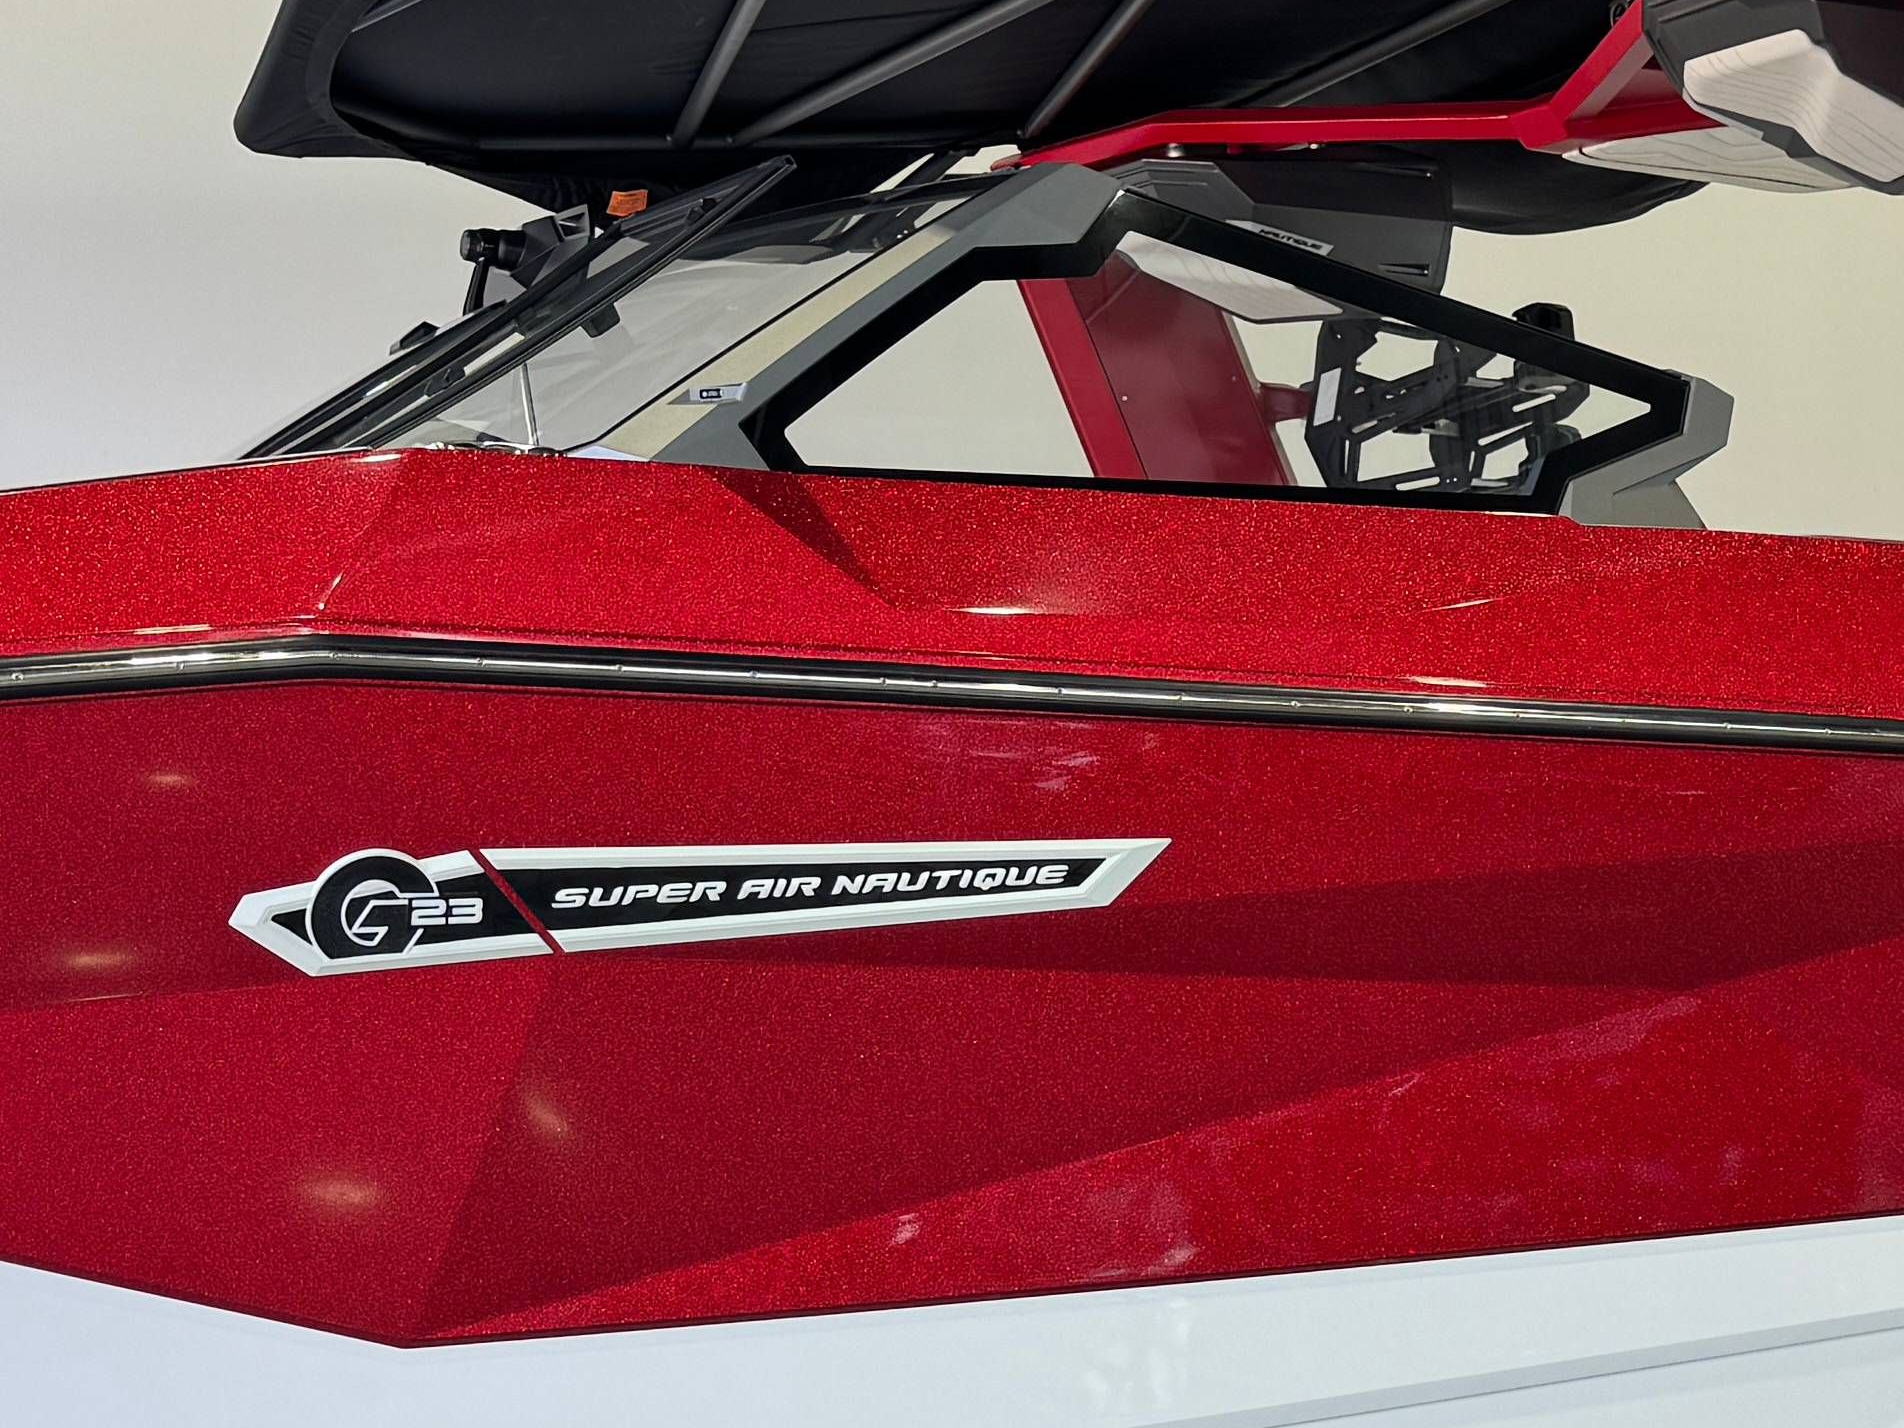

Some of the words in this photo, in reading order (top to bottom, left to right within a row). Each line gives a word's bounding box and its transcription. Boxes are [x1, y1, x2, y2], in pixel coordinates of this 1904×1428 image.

[1258, 228, 1323, 251] NAUTIQUE
[551, 880, 727, 910] SUPER
[737, 874, 820, 901] AIR
[830, 863, 1071, 896] NAUTIQUE
